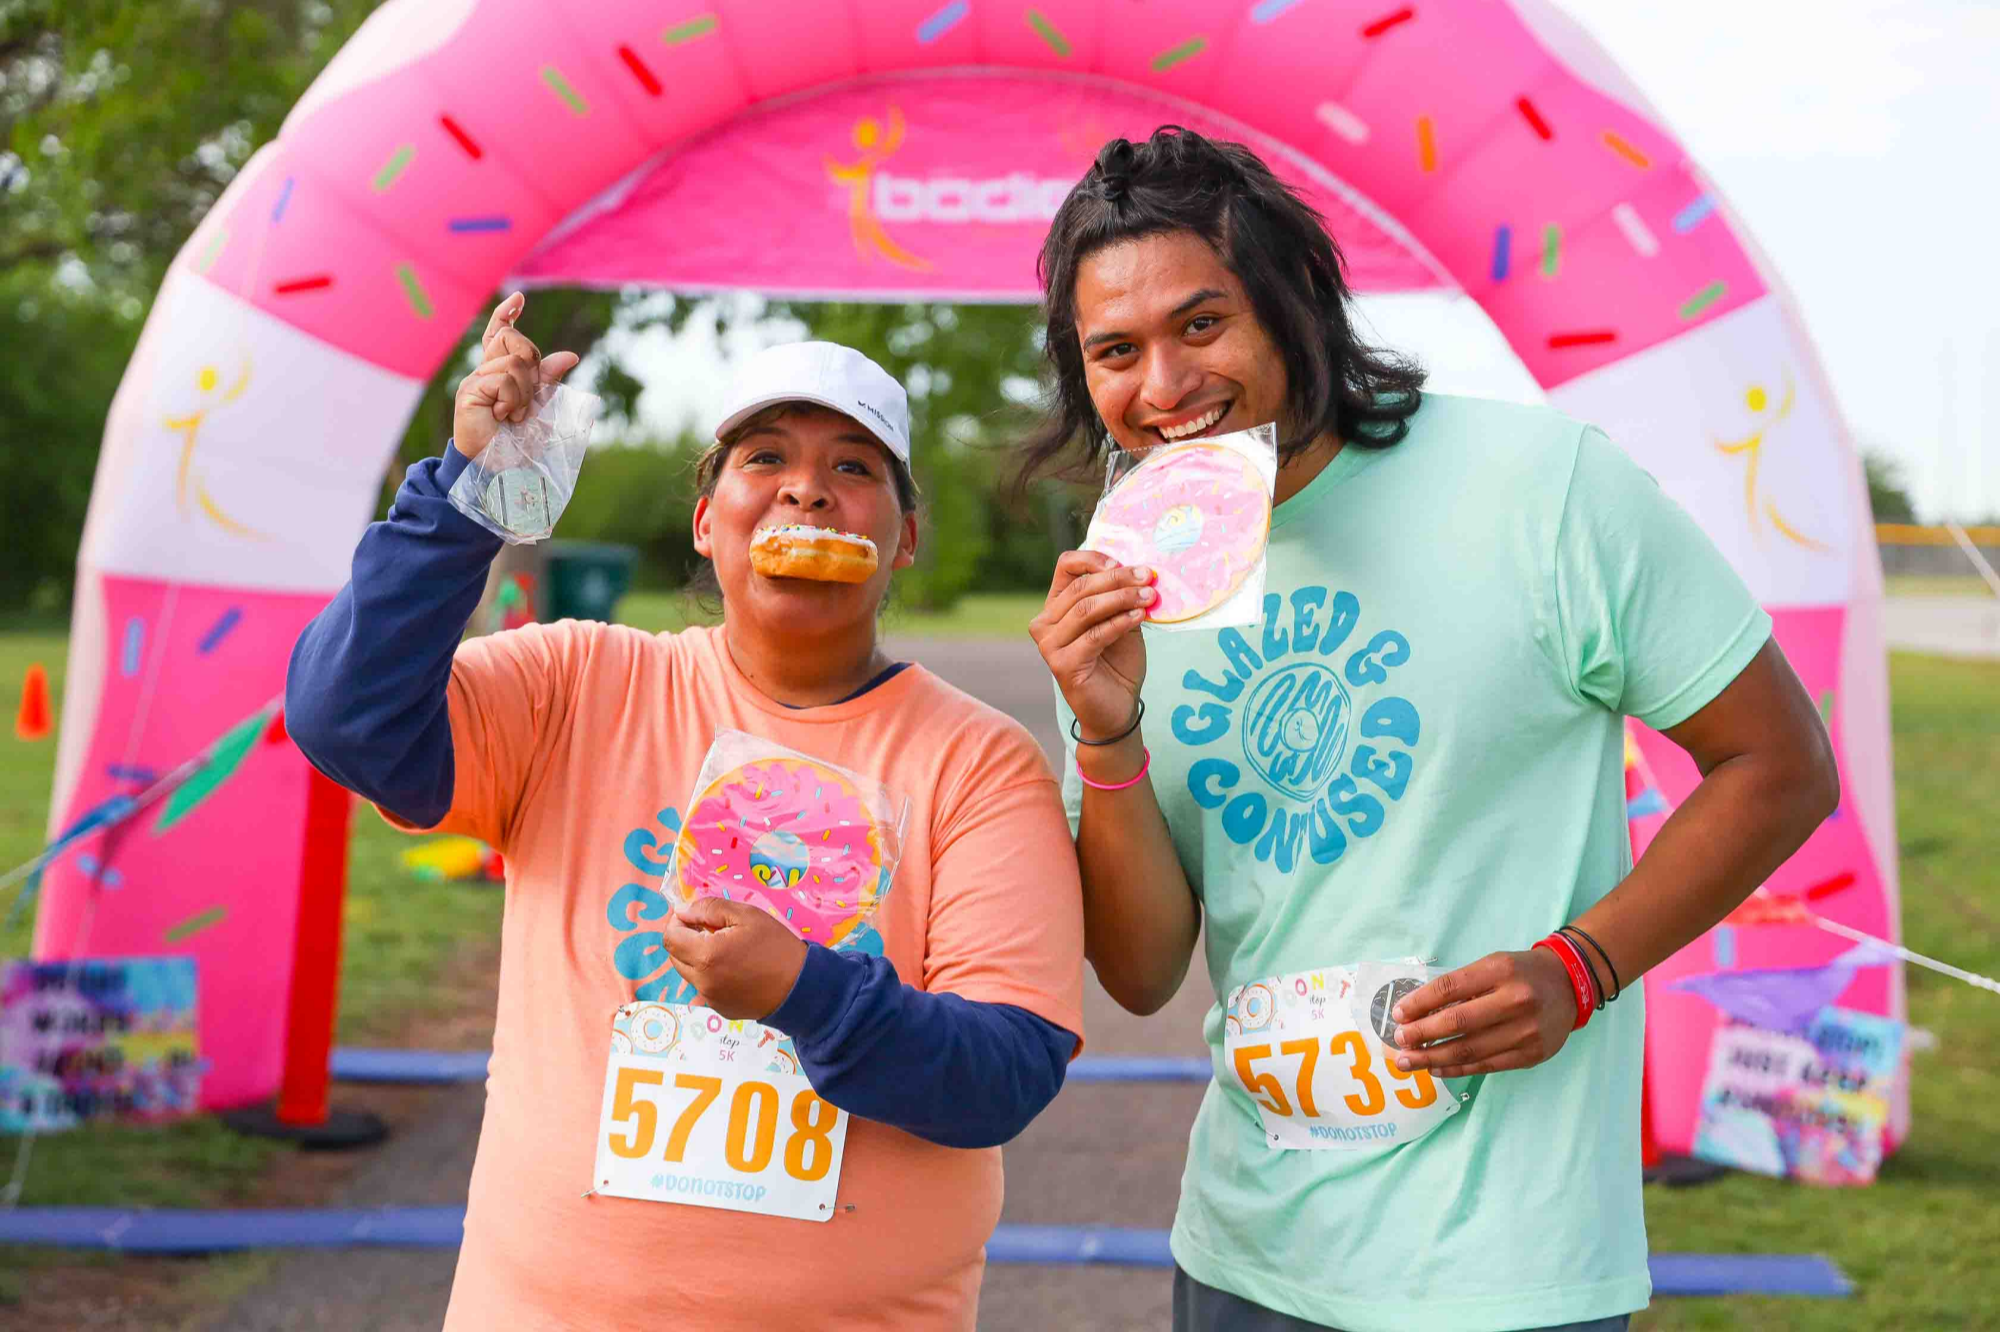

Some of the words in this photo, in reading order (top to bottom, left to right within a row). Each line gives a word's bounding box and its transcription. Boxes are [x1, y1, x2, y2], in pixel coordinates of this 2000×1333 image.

[867, 404, 894, 432] MISSION
[1170, 585, 1361, 746] GLAZED
[1186, 696, 1421, 875] CONUSED
[1311, 1008, 1325, 1021] 5K
[718, 1049, 735, 1062] 5K
[608, 1066, 839, 1182] 5708
